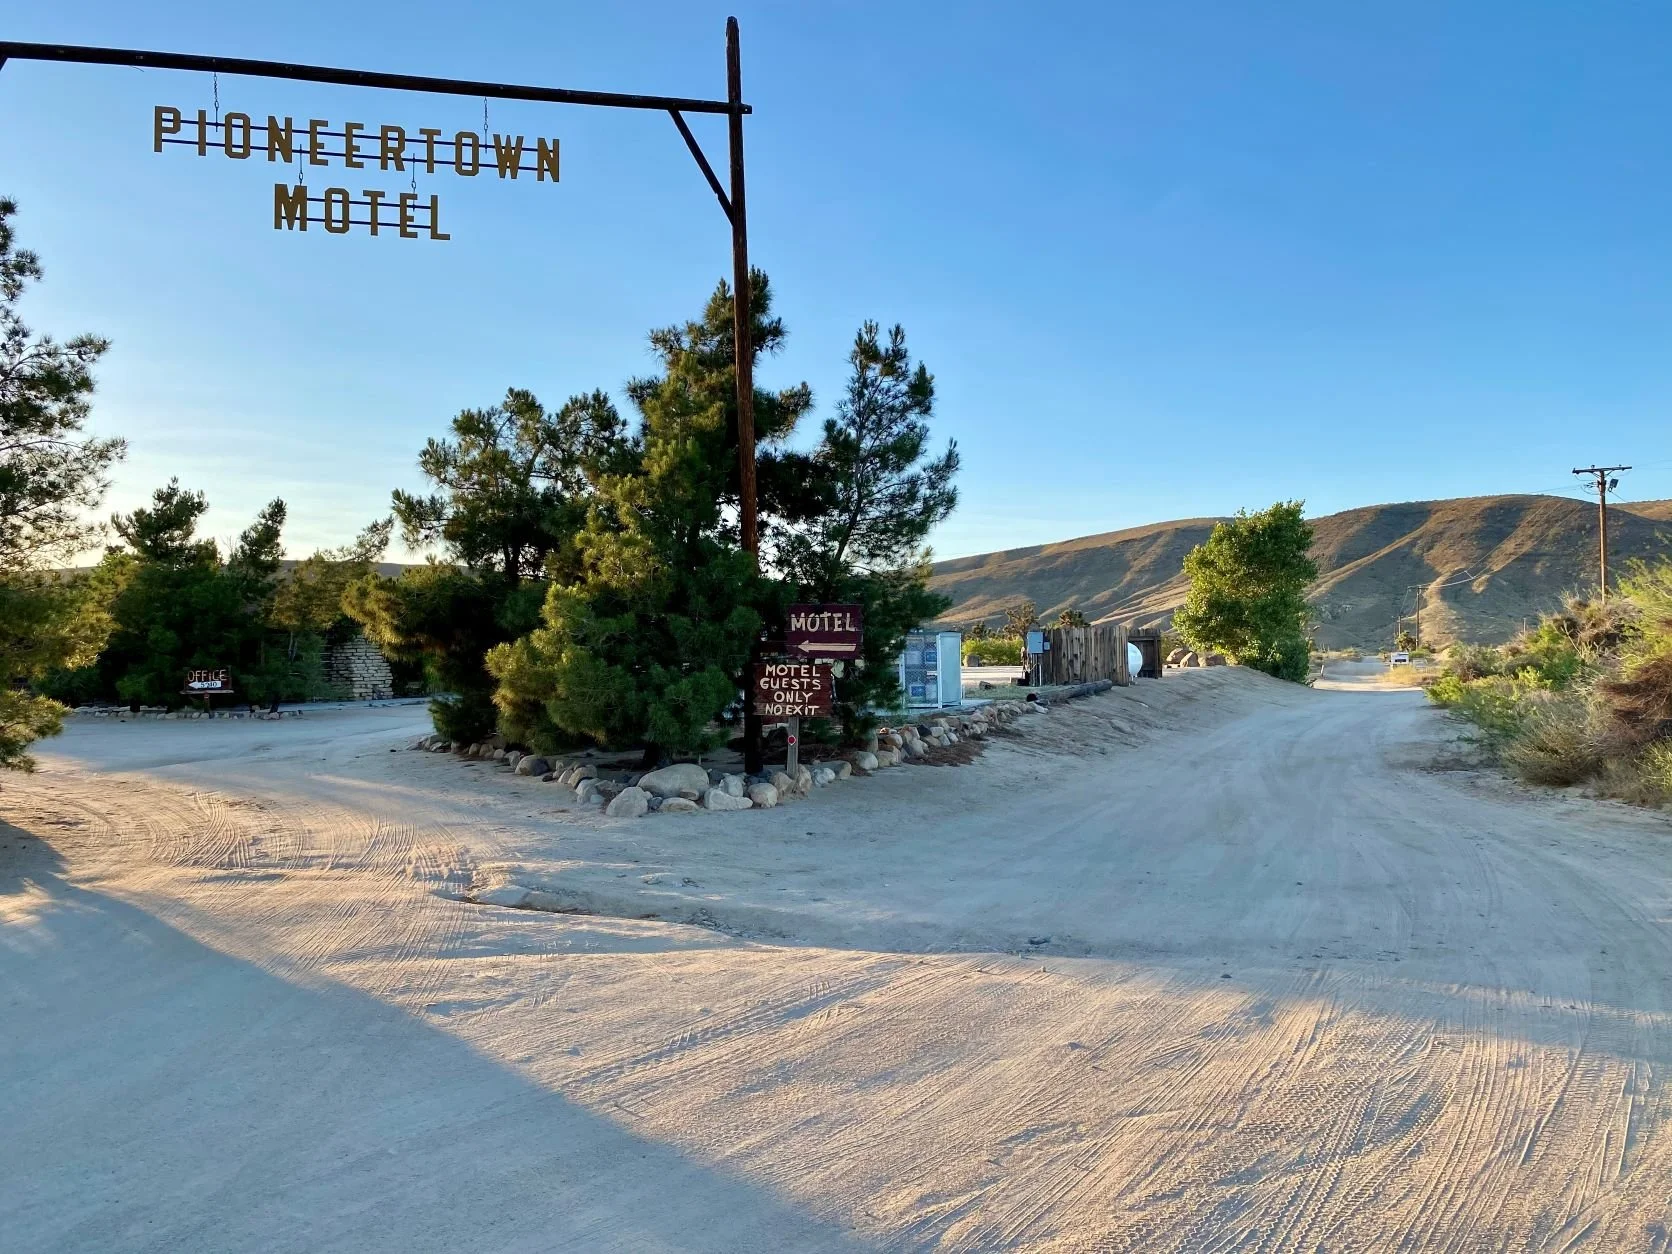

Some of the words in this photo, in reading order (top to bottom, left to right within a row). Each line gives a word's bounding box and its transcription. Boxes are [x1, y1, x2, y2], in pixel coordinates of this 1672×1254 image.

[153, 104, 561, 183] PIONEERTOWN
[273, 183, 451, 241] MOTEL
[790, 611, 857, 632] MOTEL
[765, 664, 821, 677] MOTEL
[760, 677, 821, 690] GUESTS
[774, 691, 813, 703] ONLY
[765, 703, 783, 716] NO
